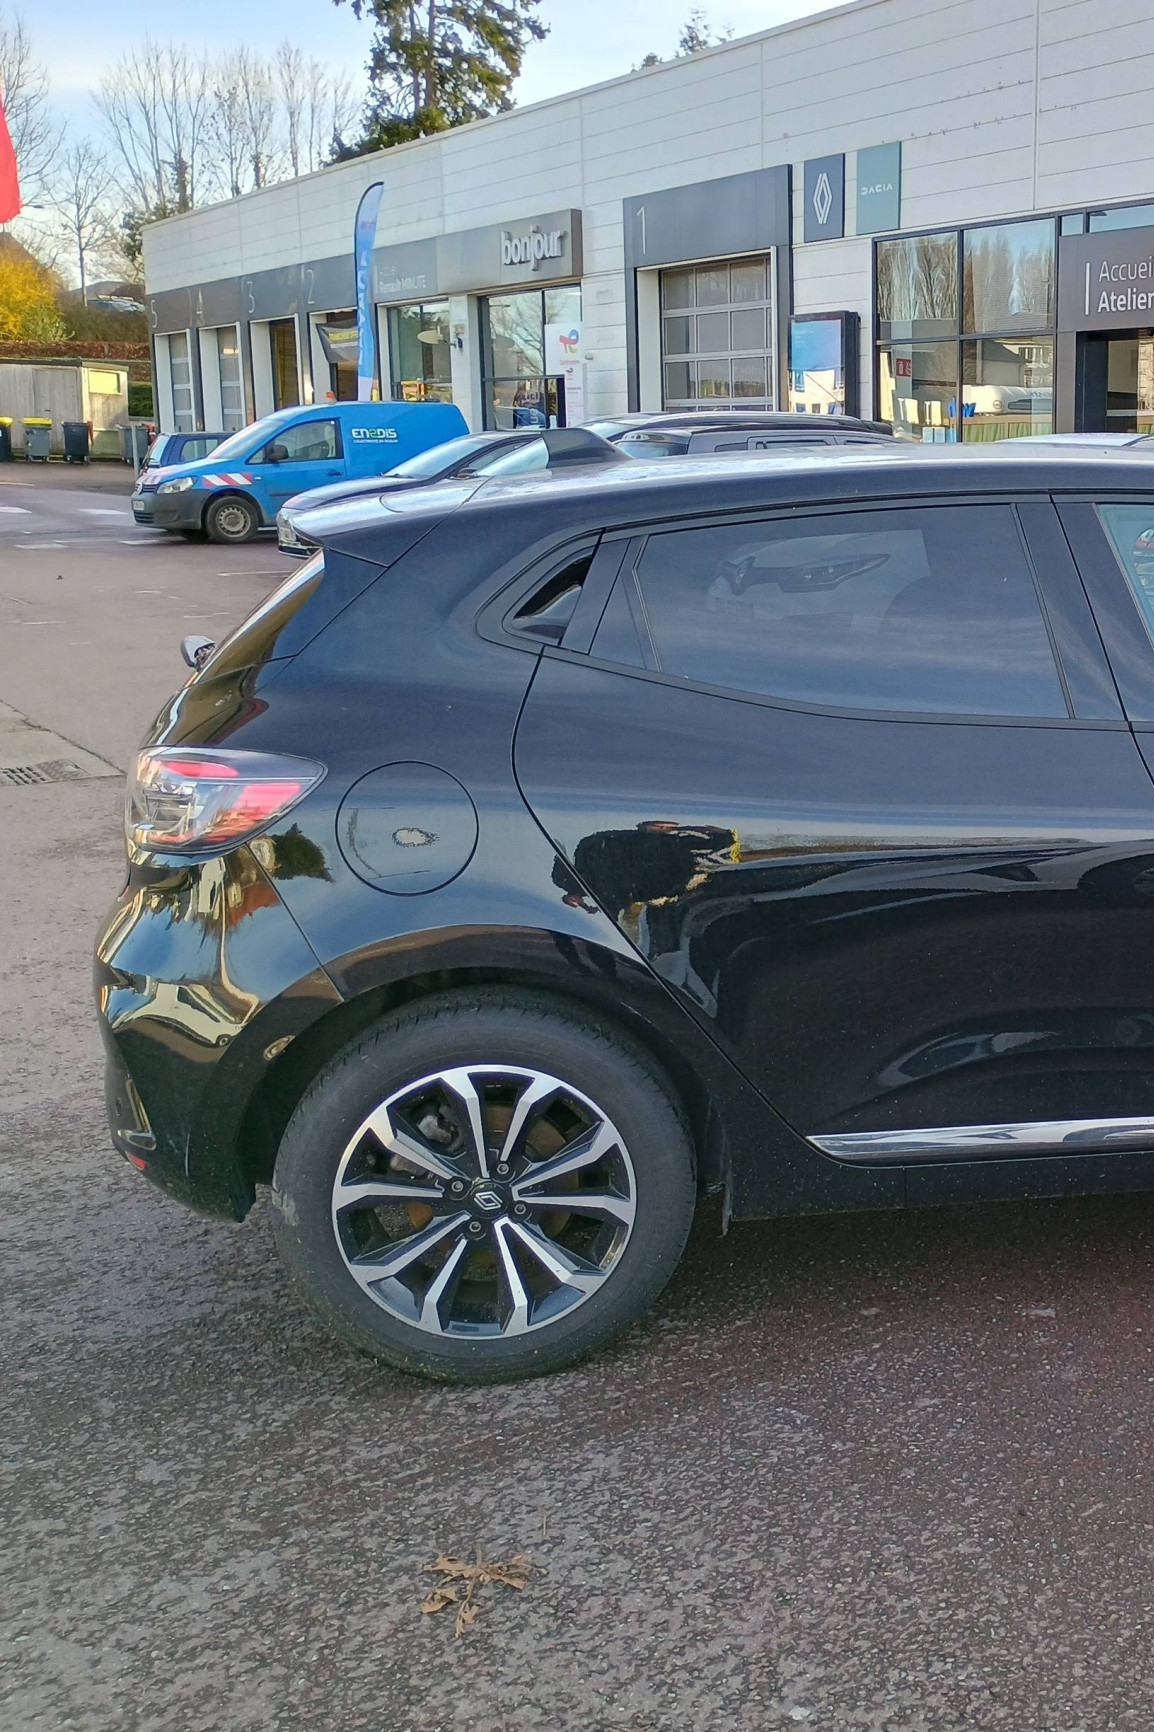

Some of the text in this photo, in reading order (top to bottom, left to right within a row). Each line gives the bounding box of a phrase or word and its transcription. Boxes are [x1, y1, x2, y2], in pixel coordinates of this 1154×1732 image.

[860, 183, 893, 196] DACIA
[636, 206, 646, 255] 1
[501, 225, 564, 271] bonjour
[246, 281, 255, 314] 3
[306, 269, 316, 305] 2
[151, 299, 158, 329] 5
